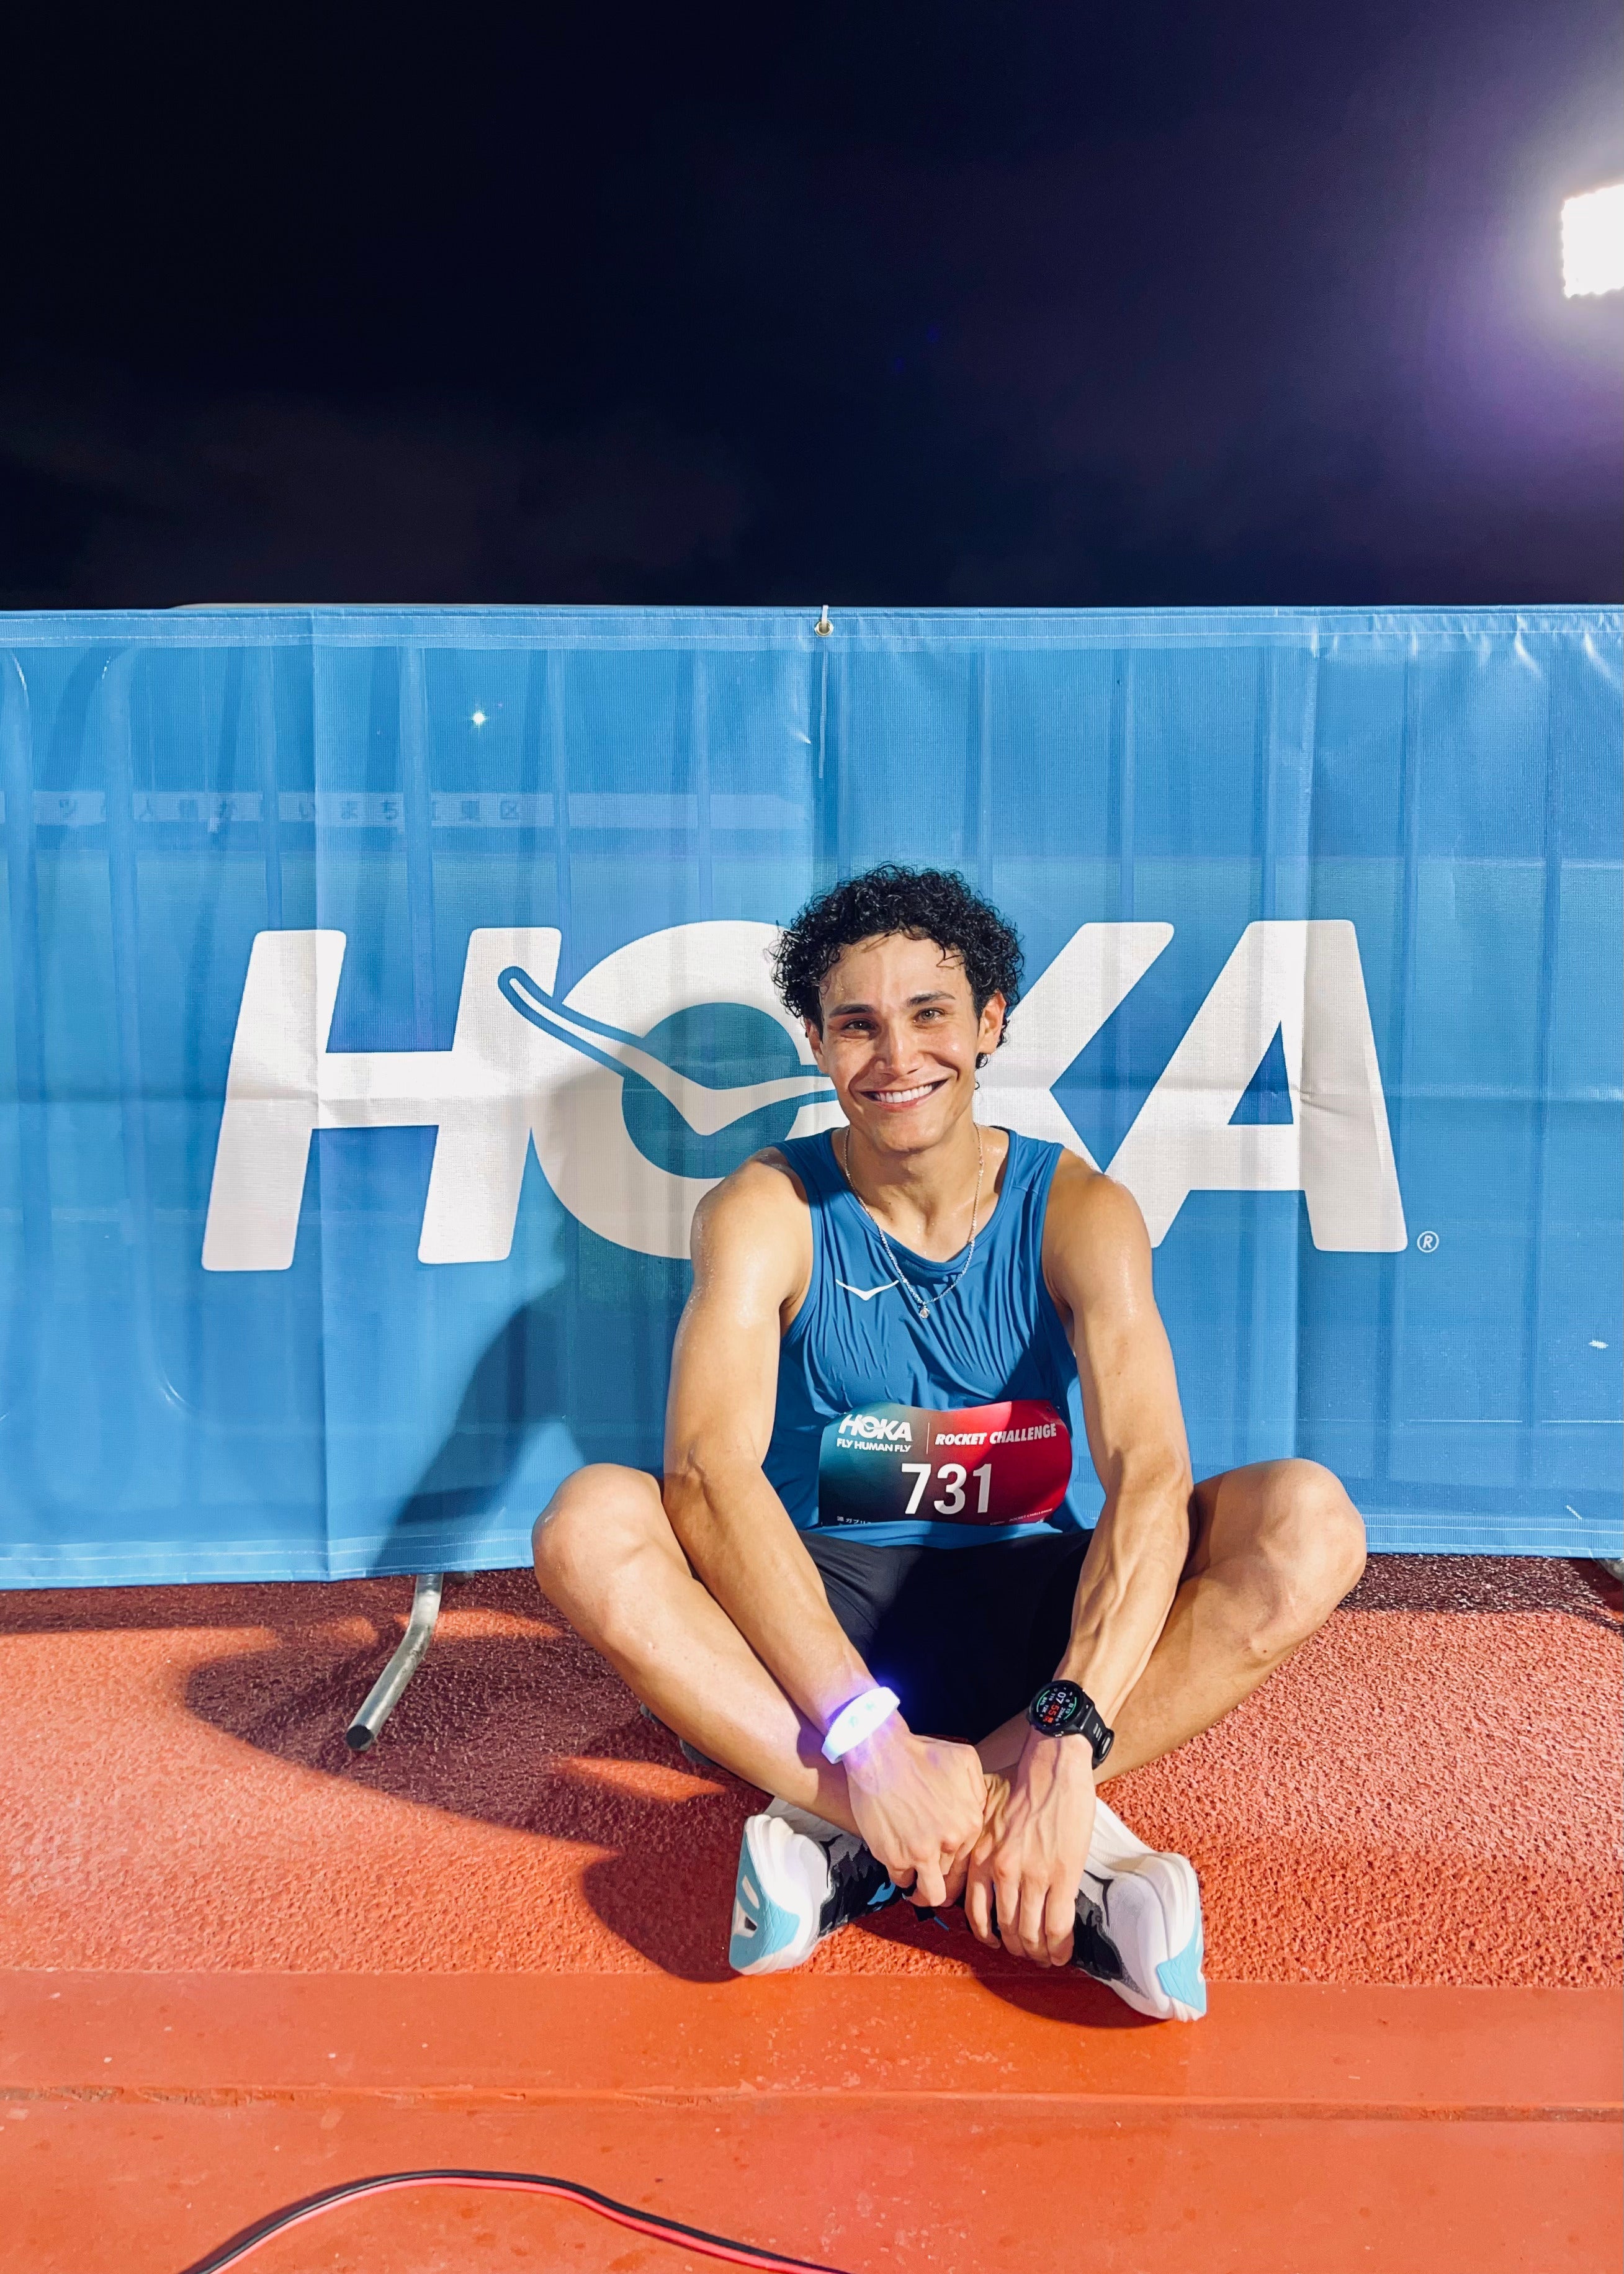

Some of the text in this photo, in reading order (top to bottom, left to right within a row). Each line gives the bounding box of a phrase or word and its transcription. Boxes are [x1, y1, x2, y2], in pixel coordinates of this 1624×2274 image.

[838, 1414, 913, 1442] HOKA
[935, 1422, 1057, 1445] ROCKET CHALLENGE
[837, 1437, 912, 1453] FLY HUMAN FLY
[901, 1463, 992, 1515] 731
